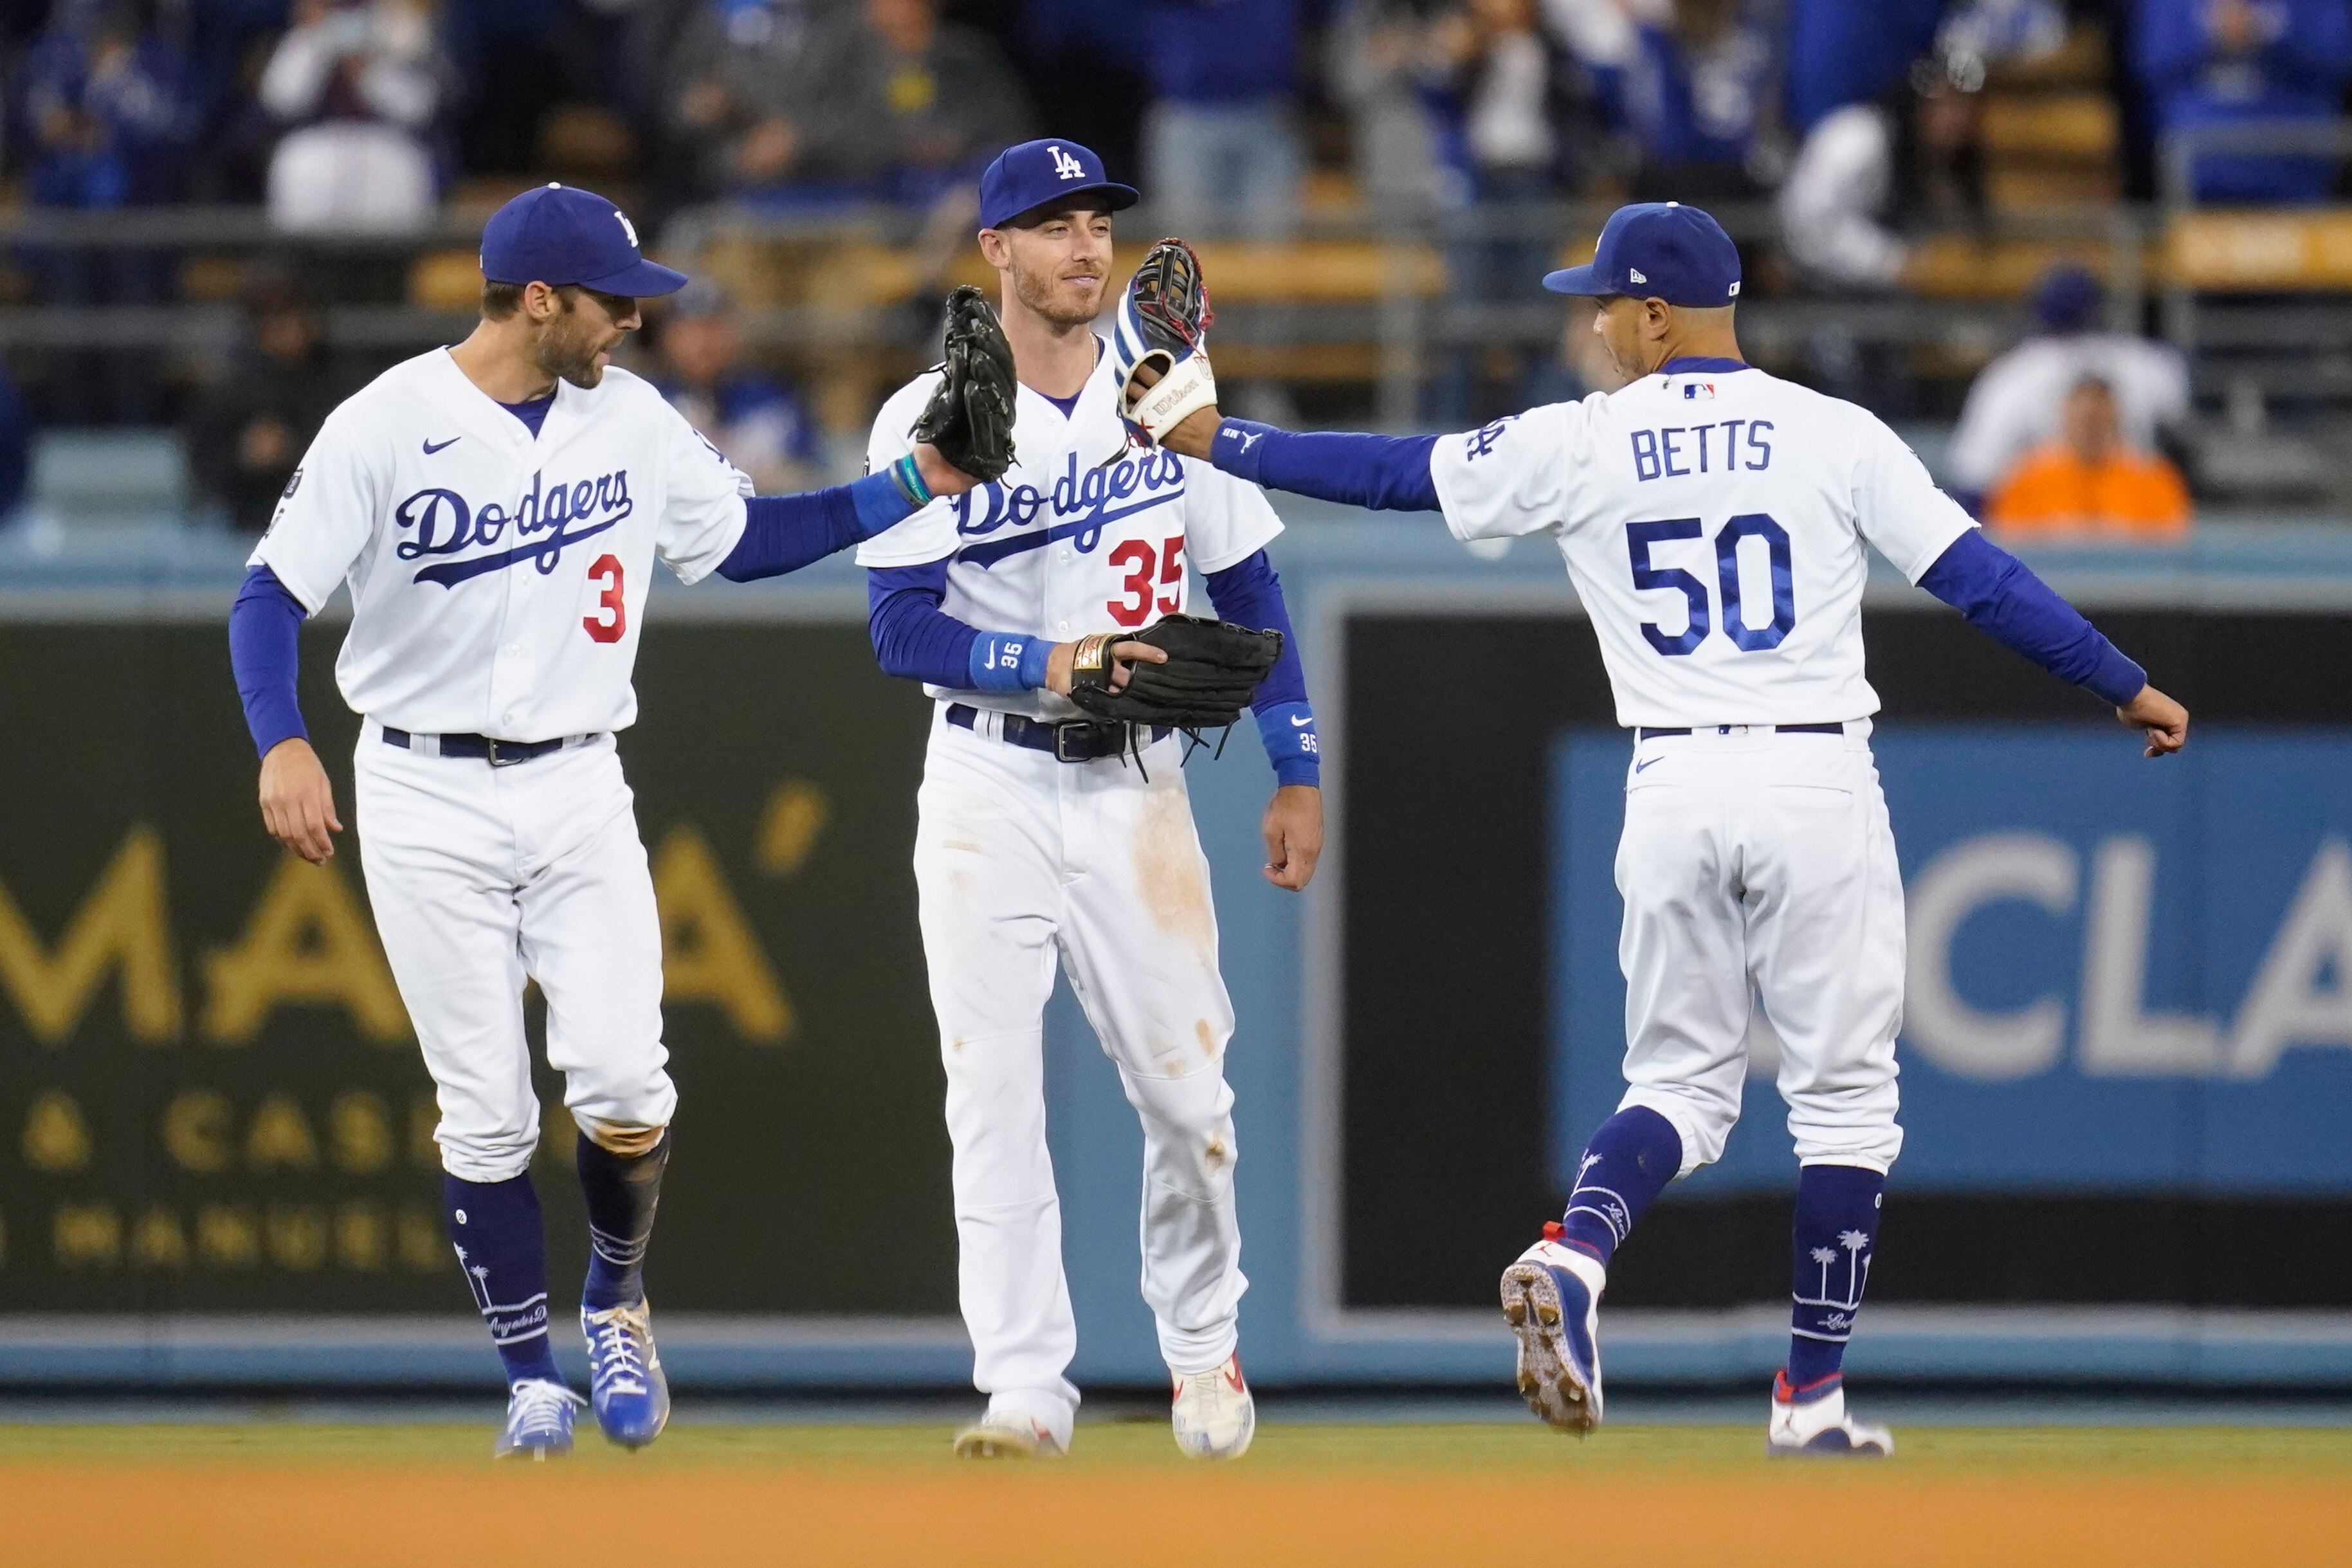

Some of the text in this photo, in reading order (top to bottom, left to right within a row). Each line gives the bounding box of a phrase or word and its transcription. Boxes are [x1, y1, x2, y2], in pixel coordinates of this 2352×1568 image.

[1046, 145, 1086, 180] LA
[1153, 379, 1199, 416] Wilson
[1630, 419, 1774, 482] BETTS
[395, 468, 633, 590] Dodgers
[949, 449, 1185, 570] Dodgers
[583, 554, 626, 643] 3
[1107, 534, 1185, 626] 35
[1625, 513, 1796, 656] 50
[1000, 641, 1023, 670] 35
[1747, 829, 2352, 1082] CLA
